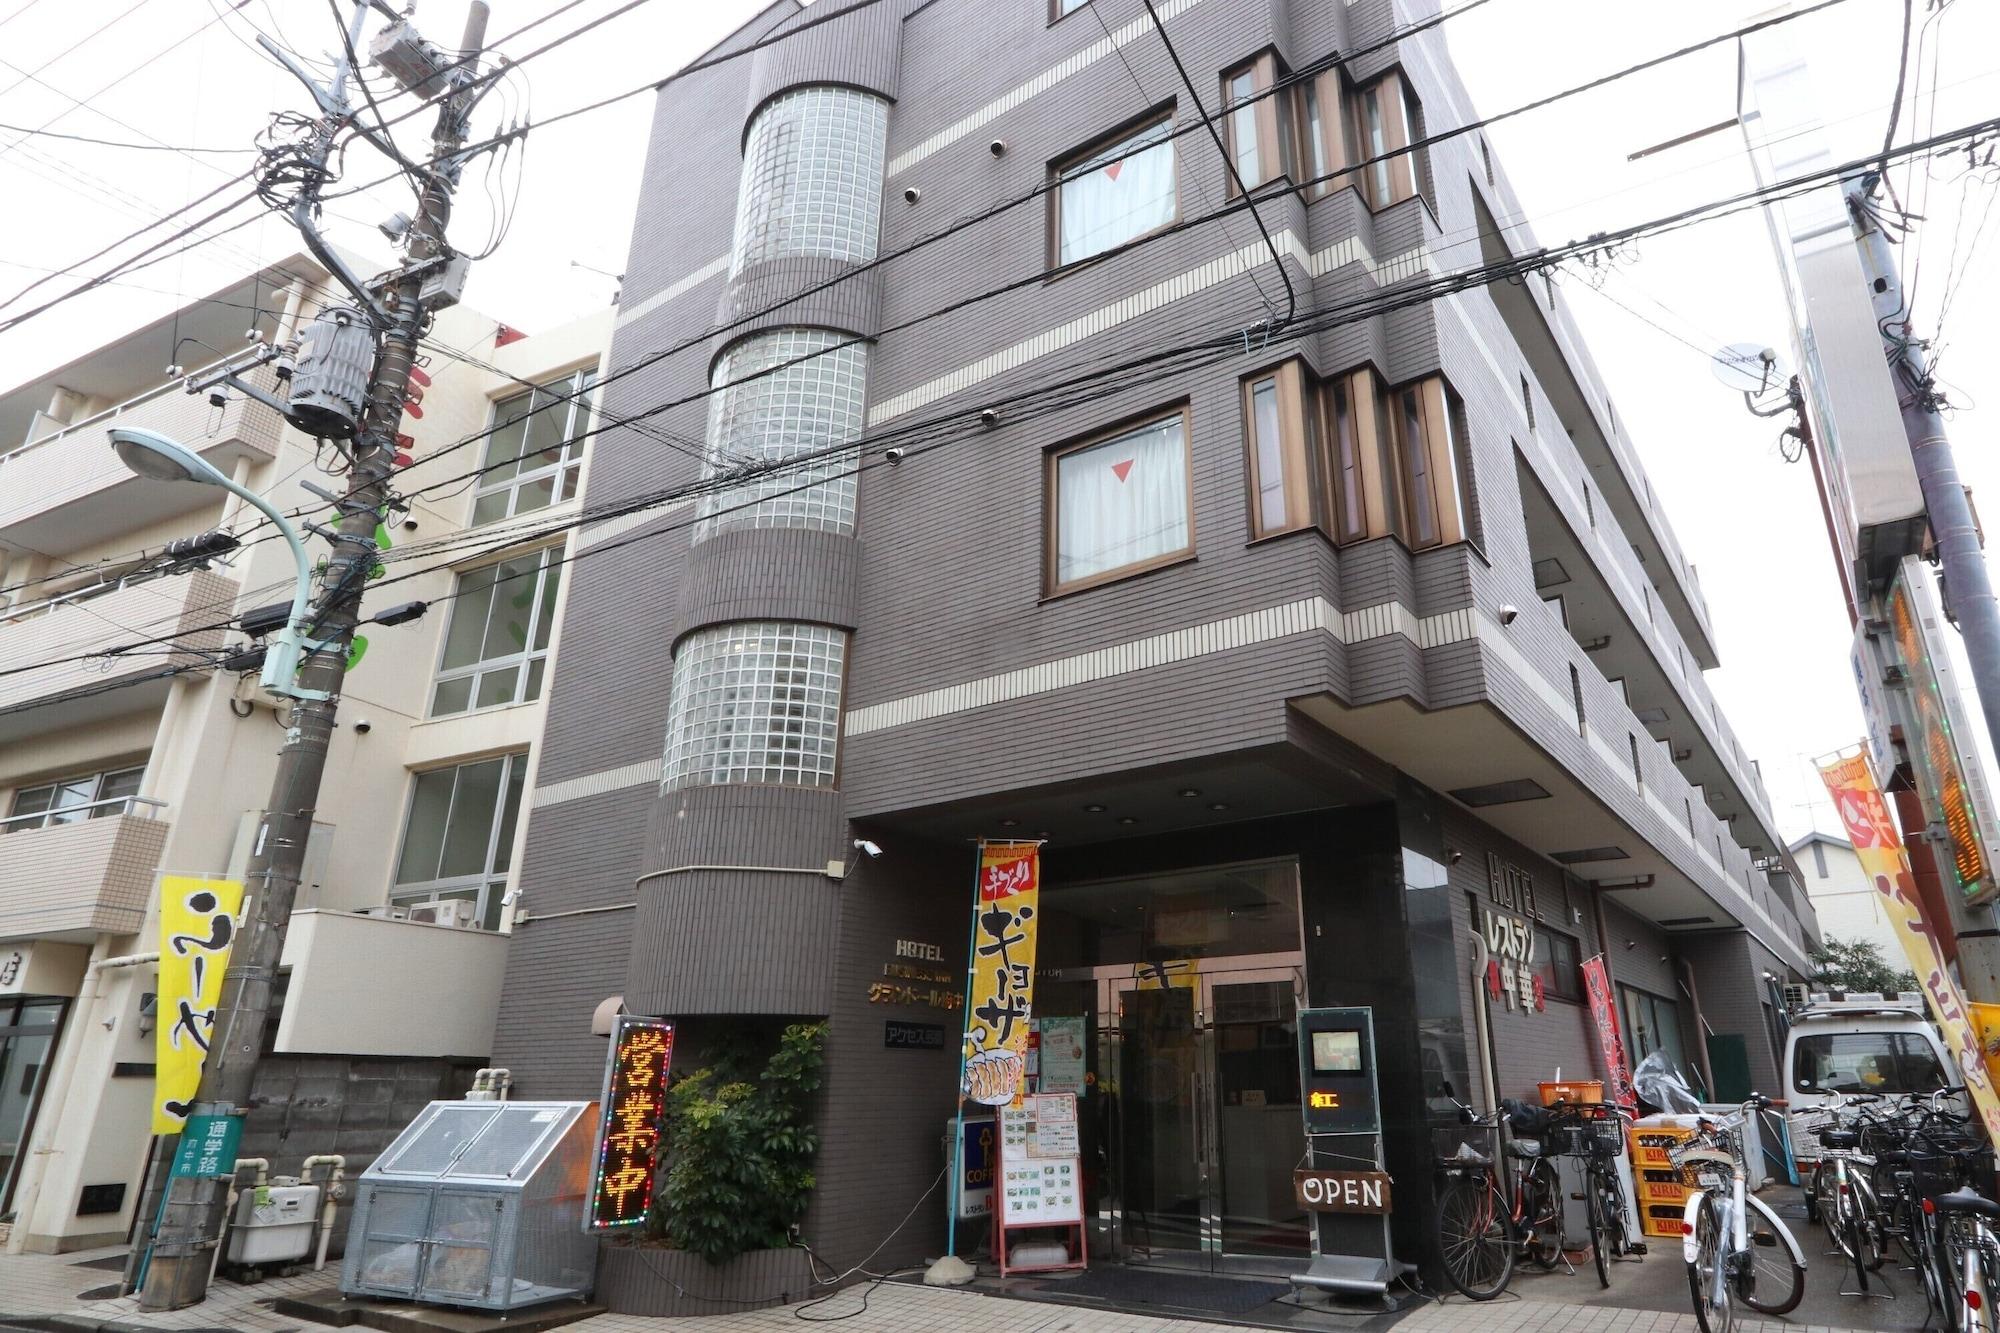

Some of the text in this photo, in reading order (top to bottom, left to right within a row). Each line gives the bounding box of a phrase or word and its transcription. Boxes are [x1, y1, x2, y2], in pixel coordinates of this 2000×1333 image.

[984, 858, 1030, 900] 手づくり
[1488, 851, 1545, 922] HOTEL
[896, 939, 944, 961] HOTEL
[1484, 909, 1536, 964] レストラン
[976, 902, 1034, 1045] ギョーザ
[1500, 957, 1535, 1015] 中華
[605, 1030, 668, 1218] 営業中
[1310, 1092, 1340, 1108] 紅
[196, 1120, 229, 1174] 通学路
[1302, 1177, 1383, 1207] OPEN
